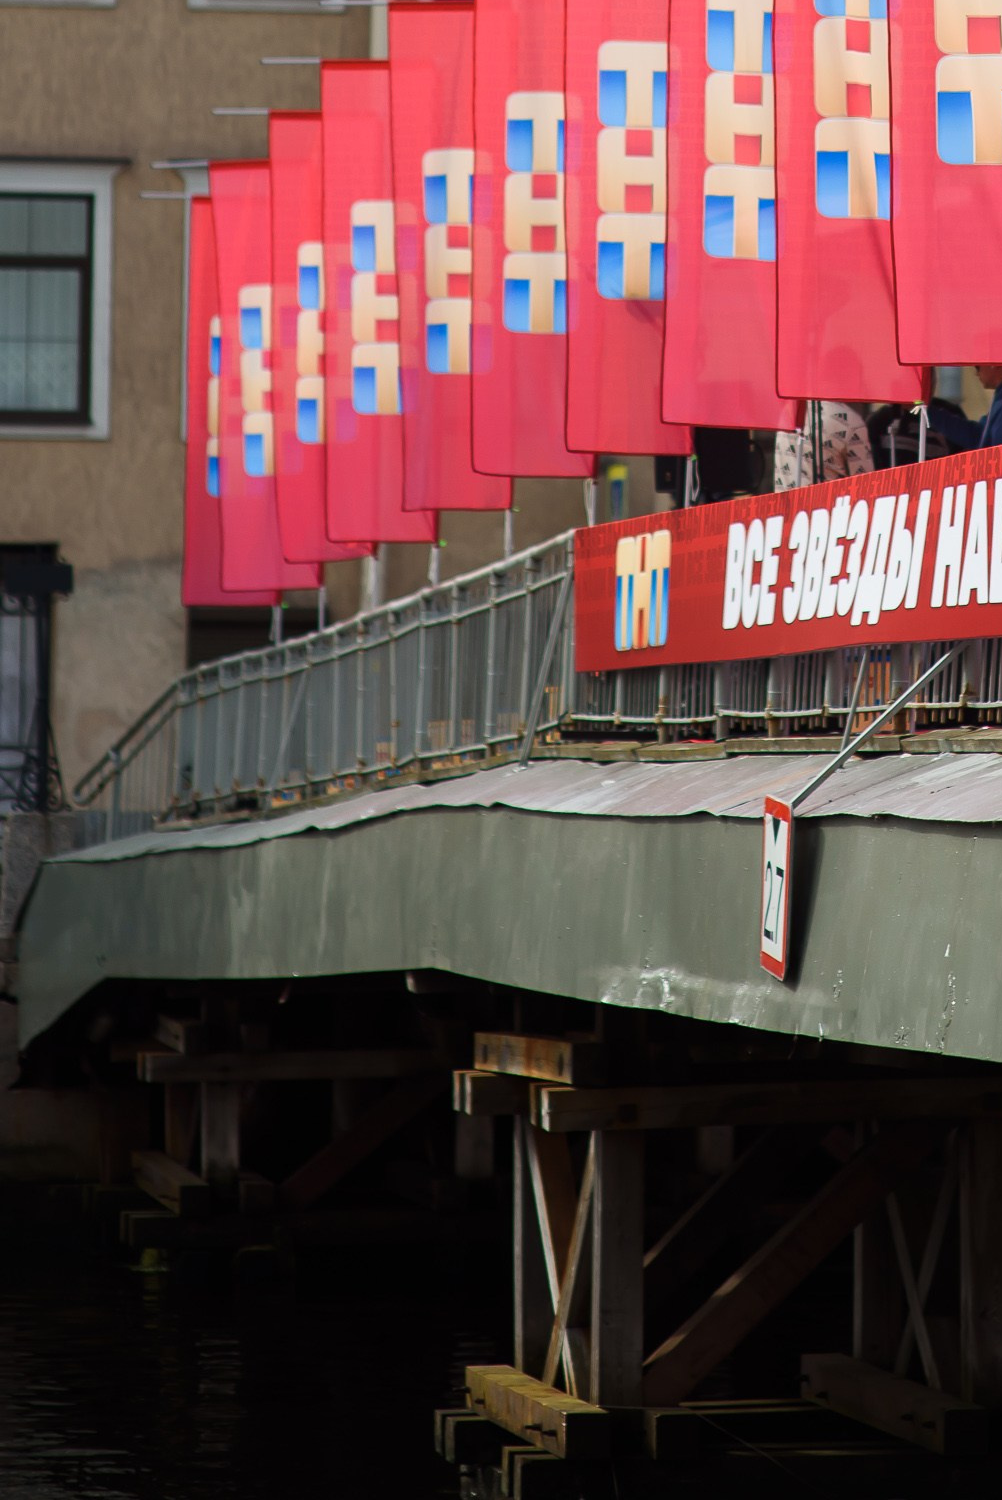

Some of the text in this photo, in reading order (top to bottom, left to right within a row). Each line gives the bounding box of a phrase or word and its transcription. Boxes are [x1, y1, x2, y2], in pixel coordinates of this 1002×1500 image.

[596, 40, 668, 300] ТНТ
[612, 527, 672, 652] ТНТ
[722, 514, 784, 630] ВСЕ
[782, 494, 932, 626] ЗВЁЗДЫ
[763, 860, 785, 945] 27
